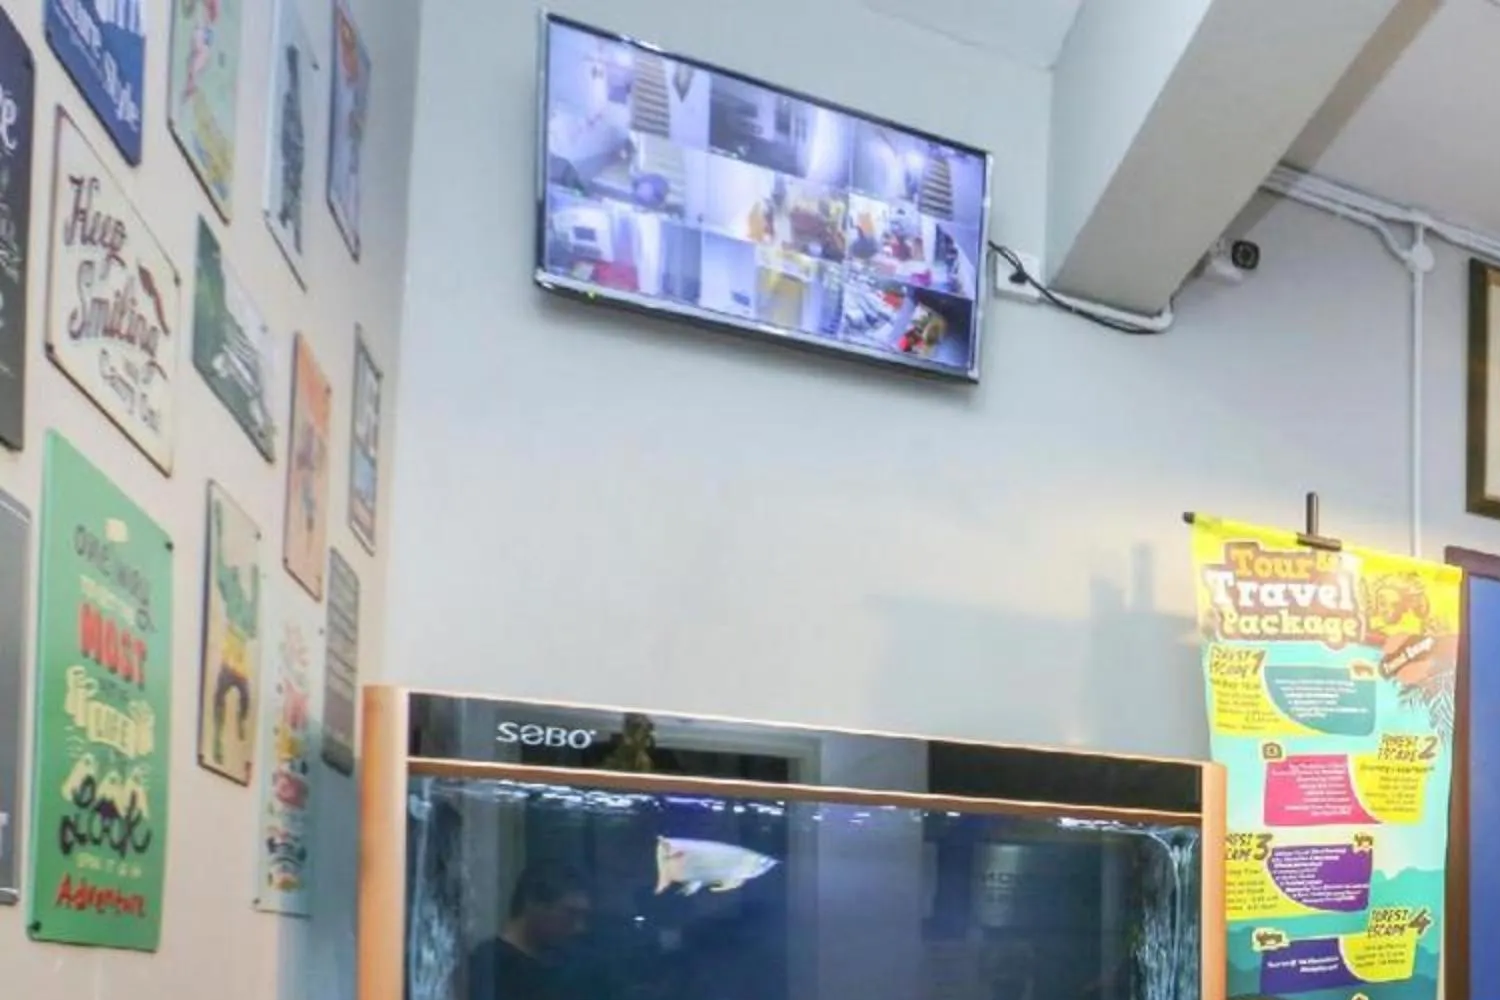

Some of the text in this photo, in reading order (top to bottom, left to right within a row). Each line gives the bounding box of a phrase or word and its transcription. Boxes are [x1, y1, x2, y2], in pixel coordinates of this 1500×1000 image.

[64, 173, 126, 280] Keep
[1229, 549, 1314, 579] Tour
[1204, 569, 1354, 612] Travel
[78, 601, 148, 690] MOST
[1220, 607, 1359, 646] Package
[1418, 735, 1438, 760] 2
[1254, 833, 1273, 861] 3
